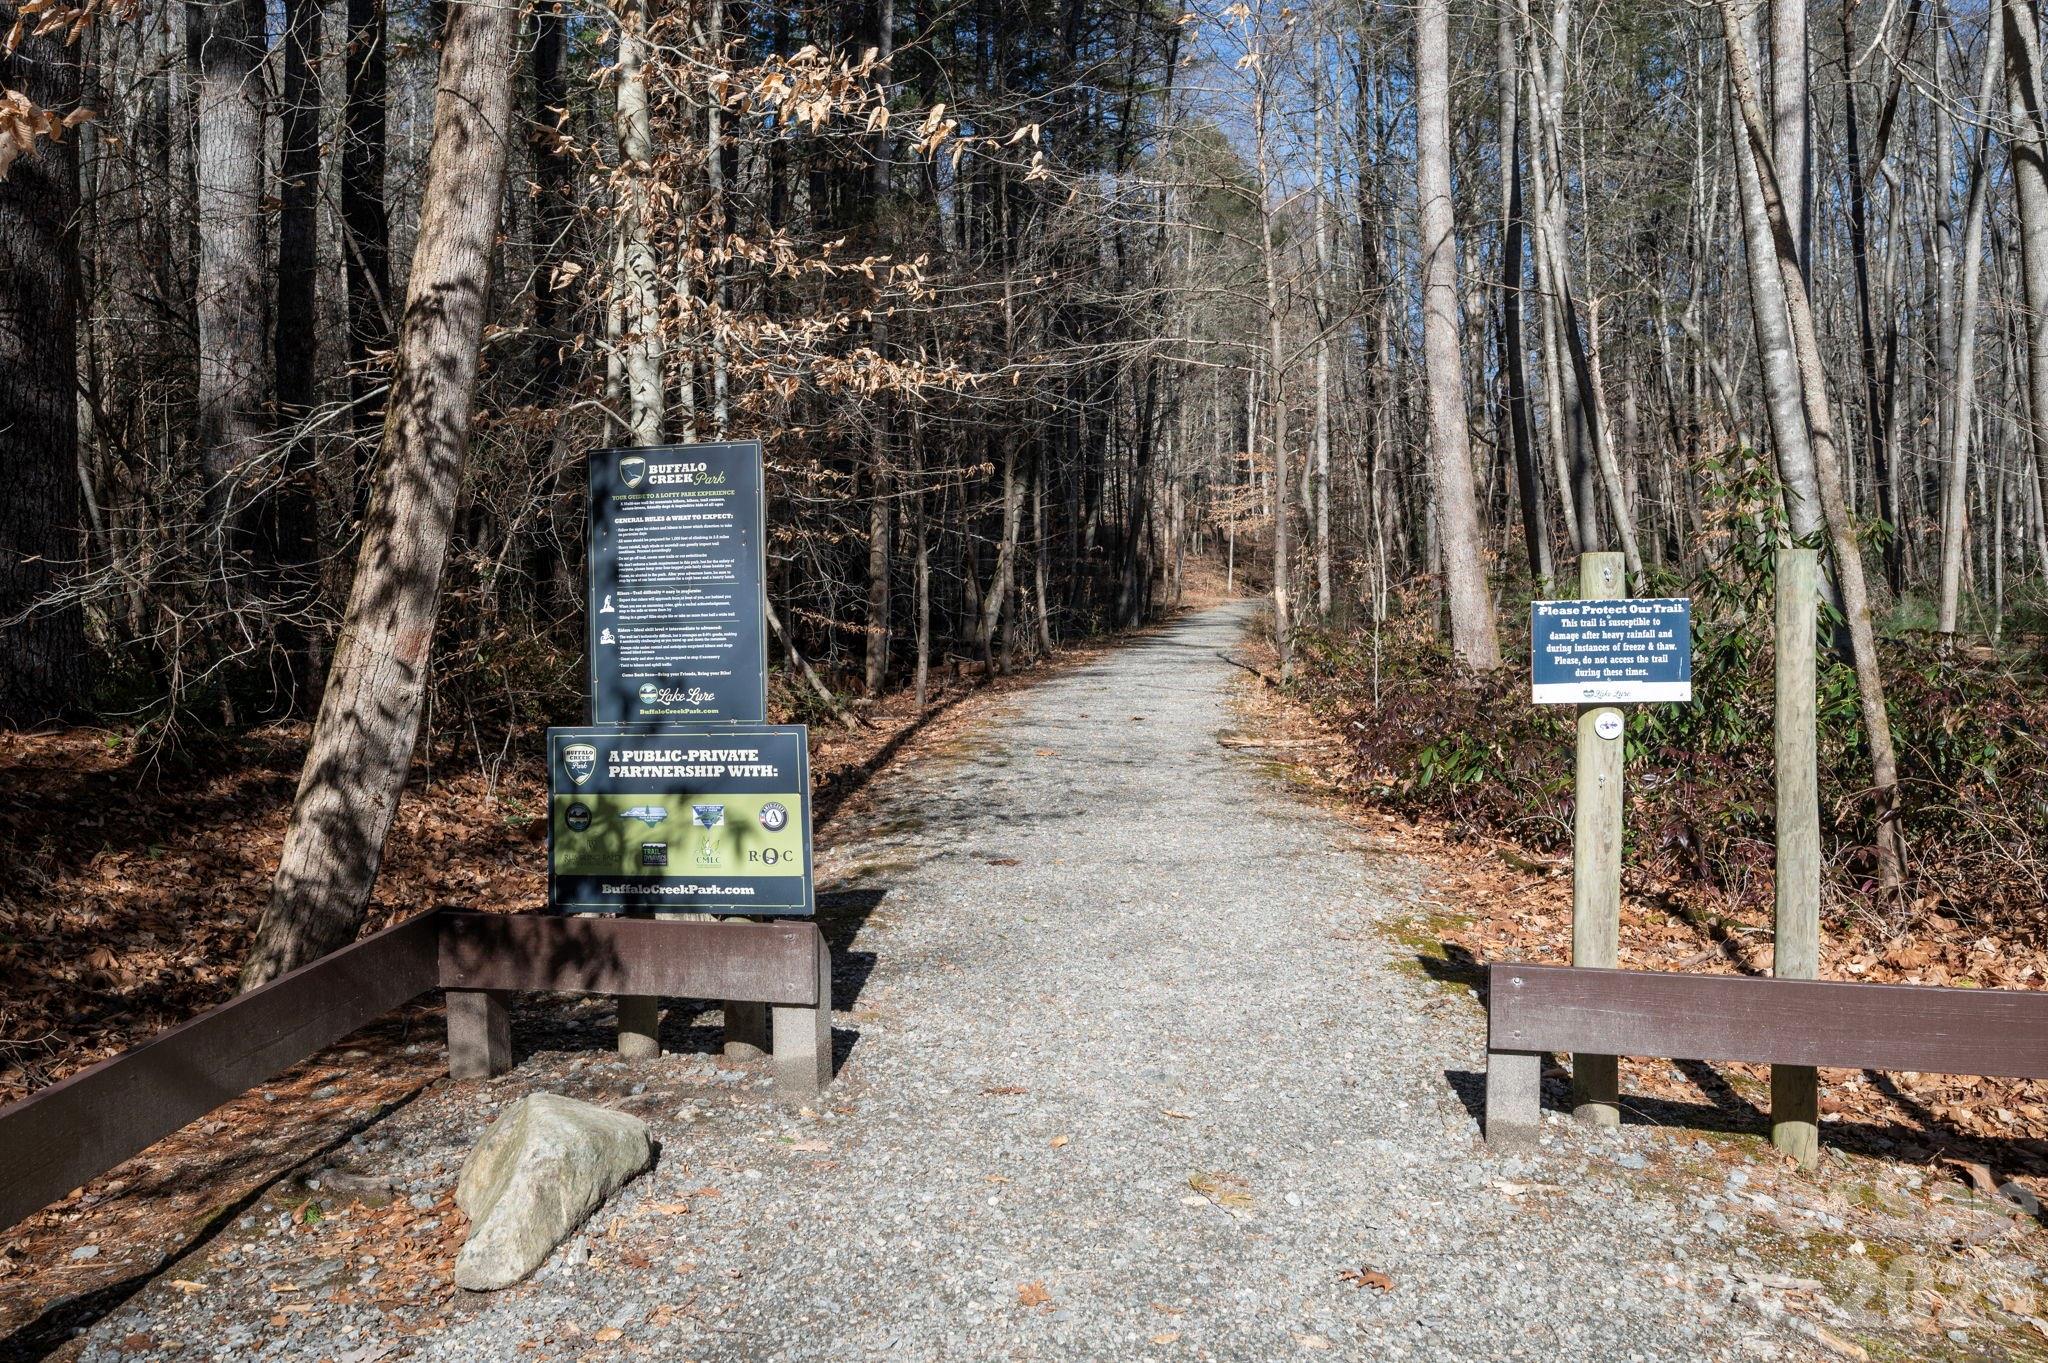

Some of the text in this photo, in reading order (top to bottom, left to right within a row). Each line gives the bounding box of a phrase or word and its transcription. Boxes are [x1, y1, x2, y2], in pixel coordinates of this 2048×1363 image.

[649, 462, 707, 474] BUFFALO
[649, 471, 726, 486] CREEK Park
[1539, 606, 1579, 616] Please
[1582, 605, 1627, 614] Protect
[1629, 604, 1652, 614] Our
[1561, 617, 1661, 628] This trail is susceptible to
[1550, 630, 1673, 641] damage after heavy rainfall and
[1547, 642, 1677, 654] during instances of freeze & thaw.
[1554, 656, 1581, 666] Please,
[1582, 656, 1592, 664] do
[1595, 656, 1607, 664] not
[1637, 655, 1649, 663] the
[1652, 654, 1668, 663] trail
[1575, 668, 1648, 678] during these times.
[657, 687, 715, 705] Lake Lure
[608, 749, 759, 763] A PUBLIC-PRIVATE
[609, 764, 779, 778] PARTNERSHIP WITH:
[769, 810, 779, 823] A
[602, 883, 755, 895] BuffaloCreekPark.com
